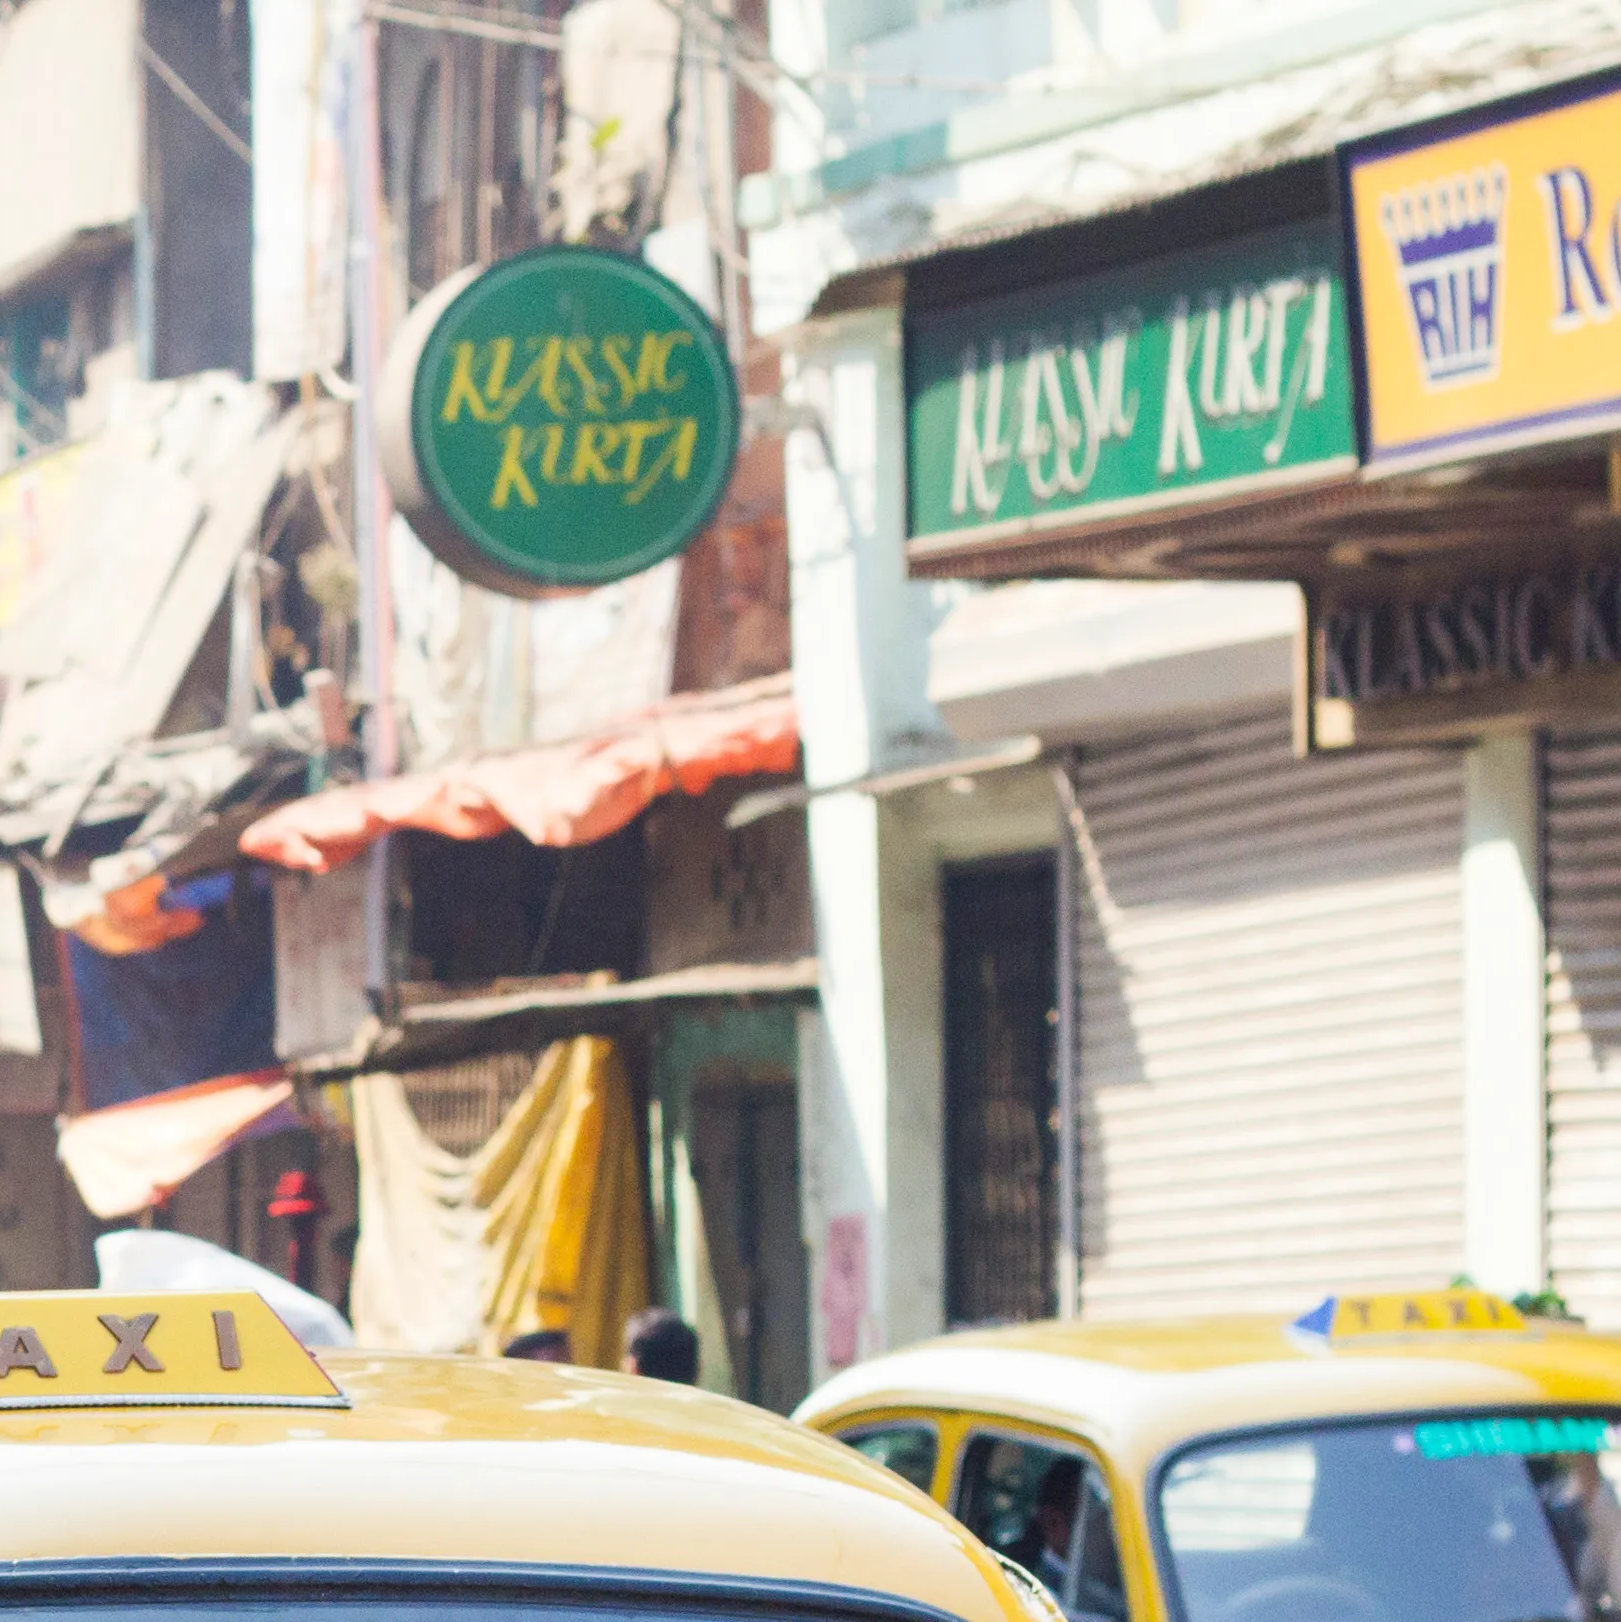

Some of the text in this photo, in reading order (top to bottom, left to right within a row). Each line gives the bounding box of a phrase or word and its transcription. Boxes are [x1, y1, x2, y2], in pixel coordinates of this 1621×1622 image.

[441, 330, 695, 423] KLASSIC
[1159, 270, 1332, 475] KURTA
[490, 416, 699, 509] KURTA
[1349, 1297, 1502, 1330] TAXI
